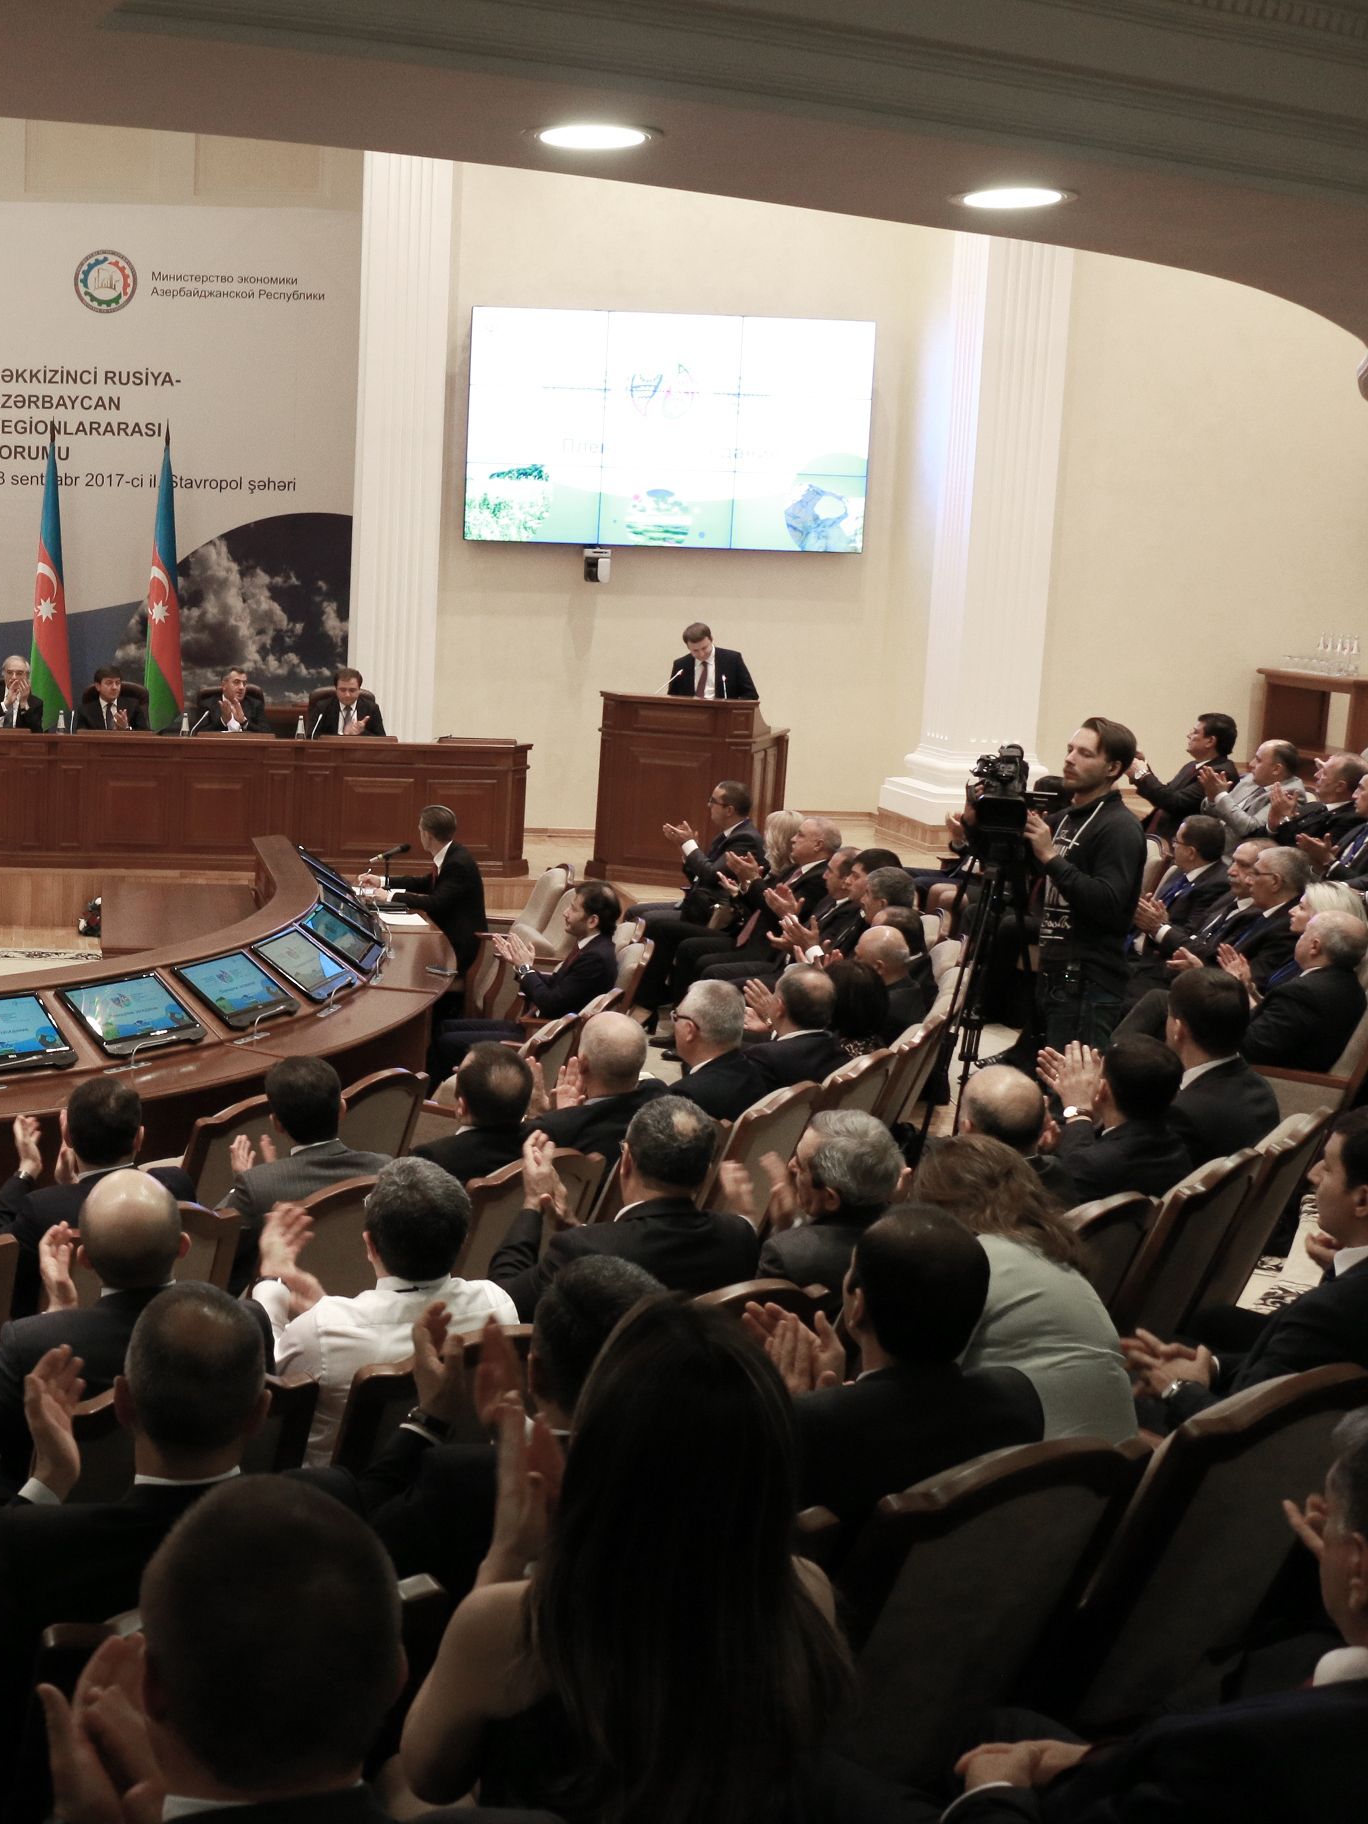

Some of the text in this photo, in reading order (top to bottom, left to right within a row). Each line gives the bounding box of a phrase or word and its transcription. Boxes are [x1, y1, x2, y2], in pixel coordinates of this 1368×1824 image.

[151, 271, 298, 286] Министерство экономики
[150, 286, 326, 304] Азербайджанской Республики
[104, 367, 182, 388] RUSİYA-
[10, 472, 81, 487] sentabr
[85, 472, 144, 489] 2017-ci
[172, 473, 243, 493] Stavropol
[247, 476, 297, 495] şəhəri
